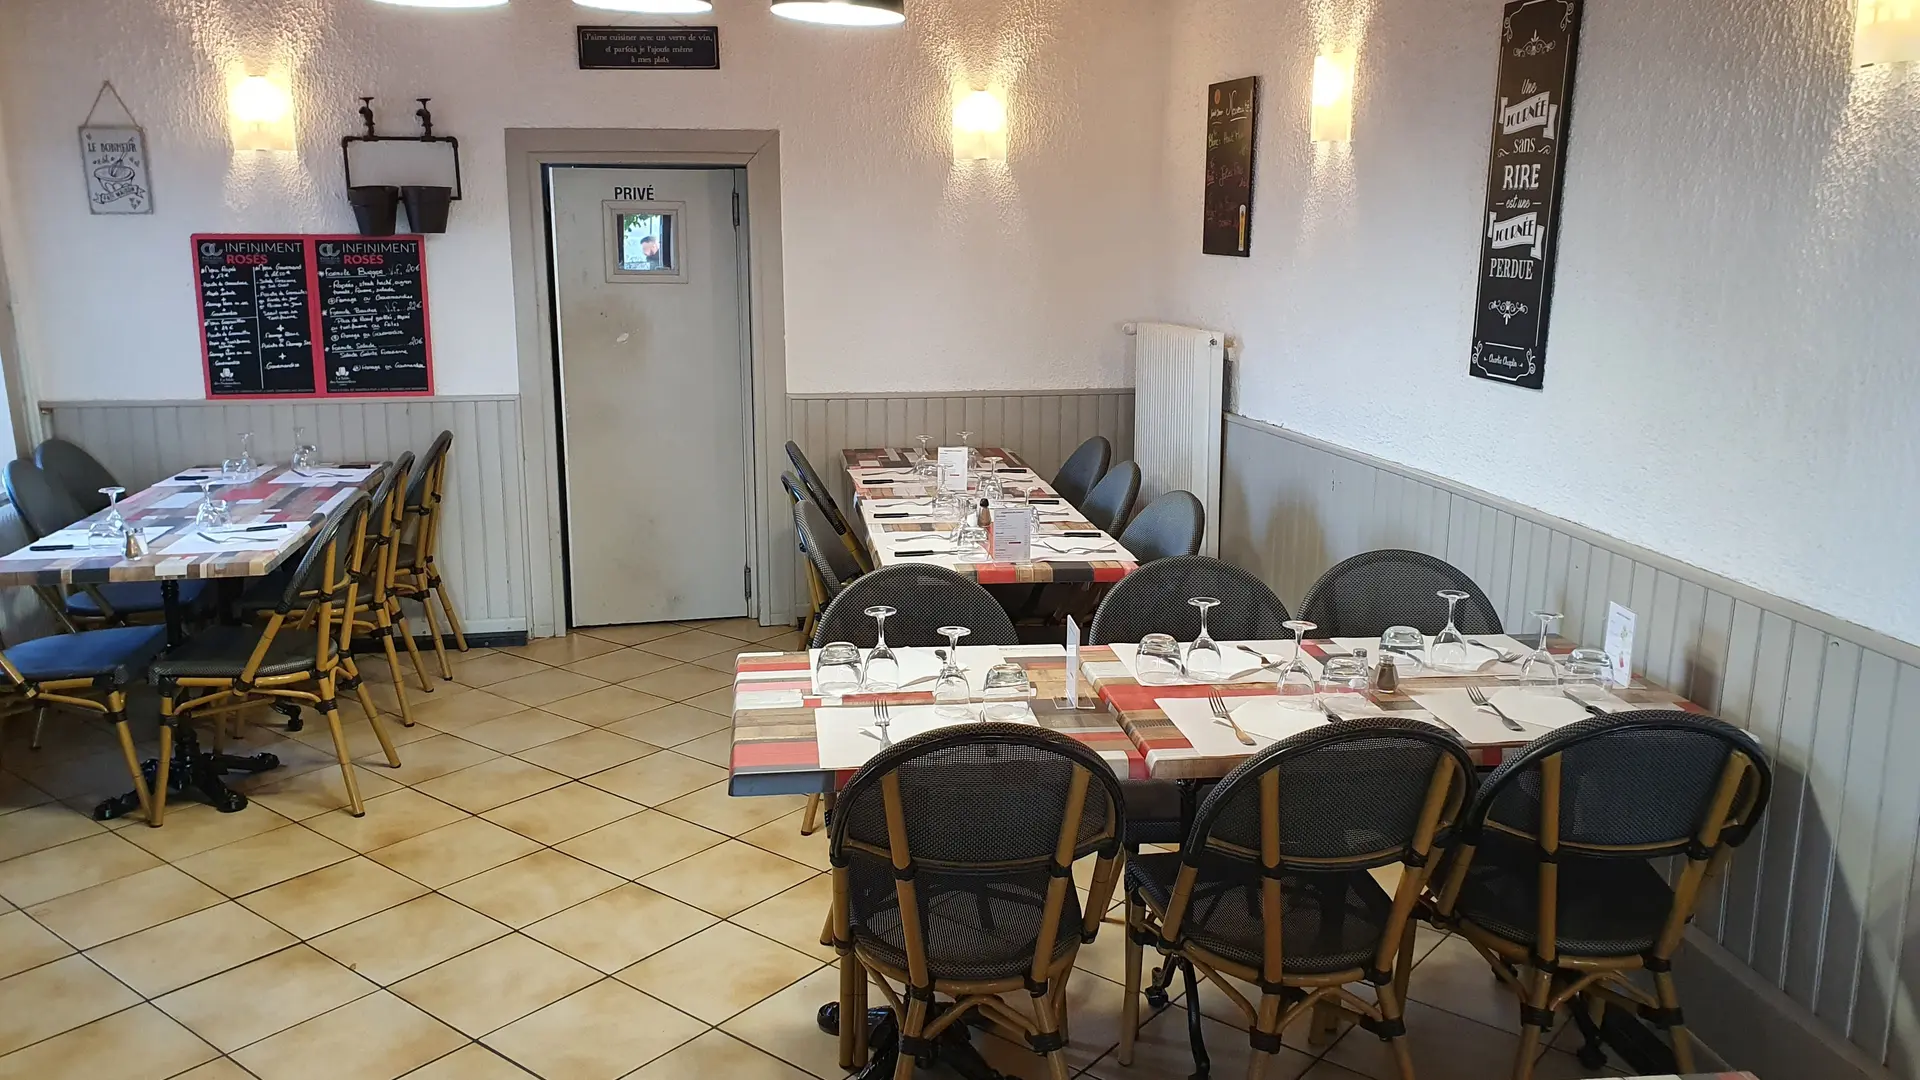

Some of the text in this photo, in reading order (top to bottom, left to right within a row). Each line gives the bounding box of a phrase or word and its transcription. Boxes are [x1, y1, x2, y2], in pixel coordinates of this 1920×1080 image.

[614, 46, 637, 54] parfois
[647, 46, 670, 54] l'ajoute
[654, 56, 670, 64] plats
[1522, 78, 1537, 94] Une
[1505, 98, 1546, 128] JOURNÉE
[88, 143, 137, 152] LE BONHEUR
[1513, 137, 1536, 154] sans
[1502, 164, 1541, 190] RIRE
[614, 185, 654, 200] PRIVÉ
[1505, 194, 1531, 208] est une
[1494, 217, 1534, 242] JOURNÉE
[224, 242, 302, 253] INFINIMENT
[342, 243, 416, 253] INFINIMENT
[226, 253, 268, 264] ROSÉS
[344, 253, 384, 264] ROSÉS
[1489, 258, 1534, 280] PERDUE
